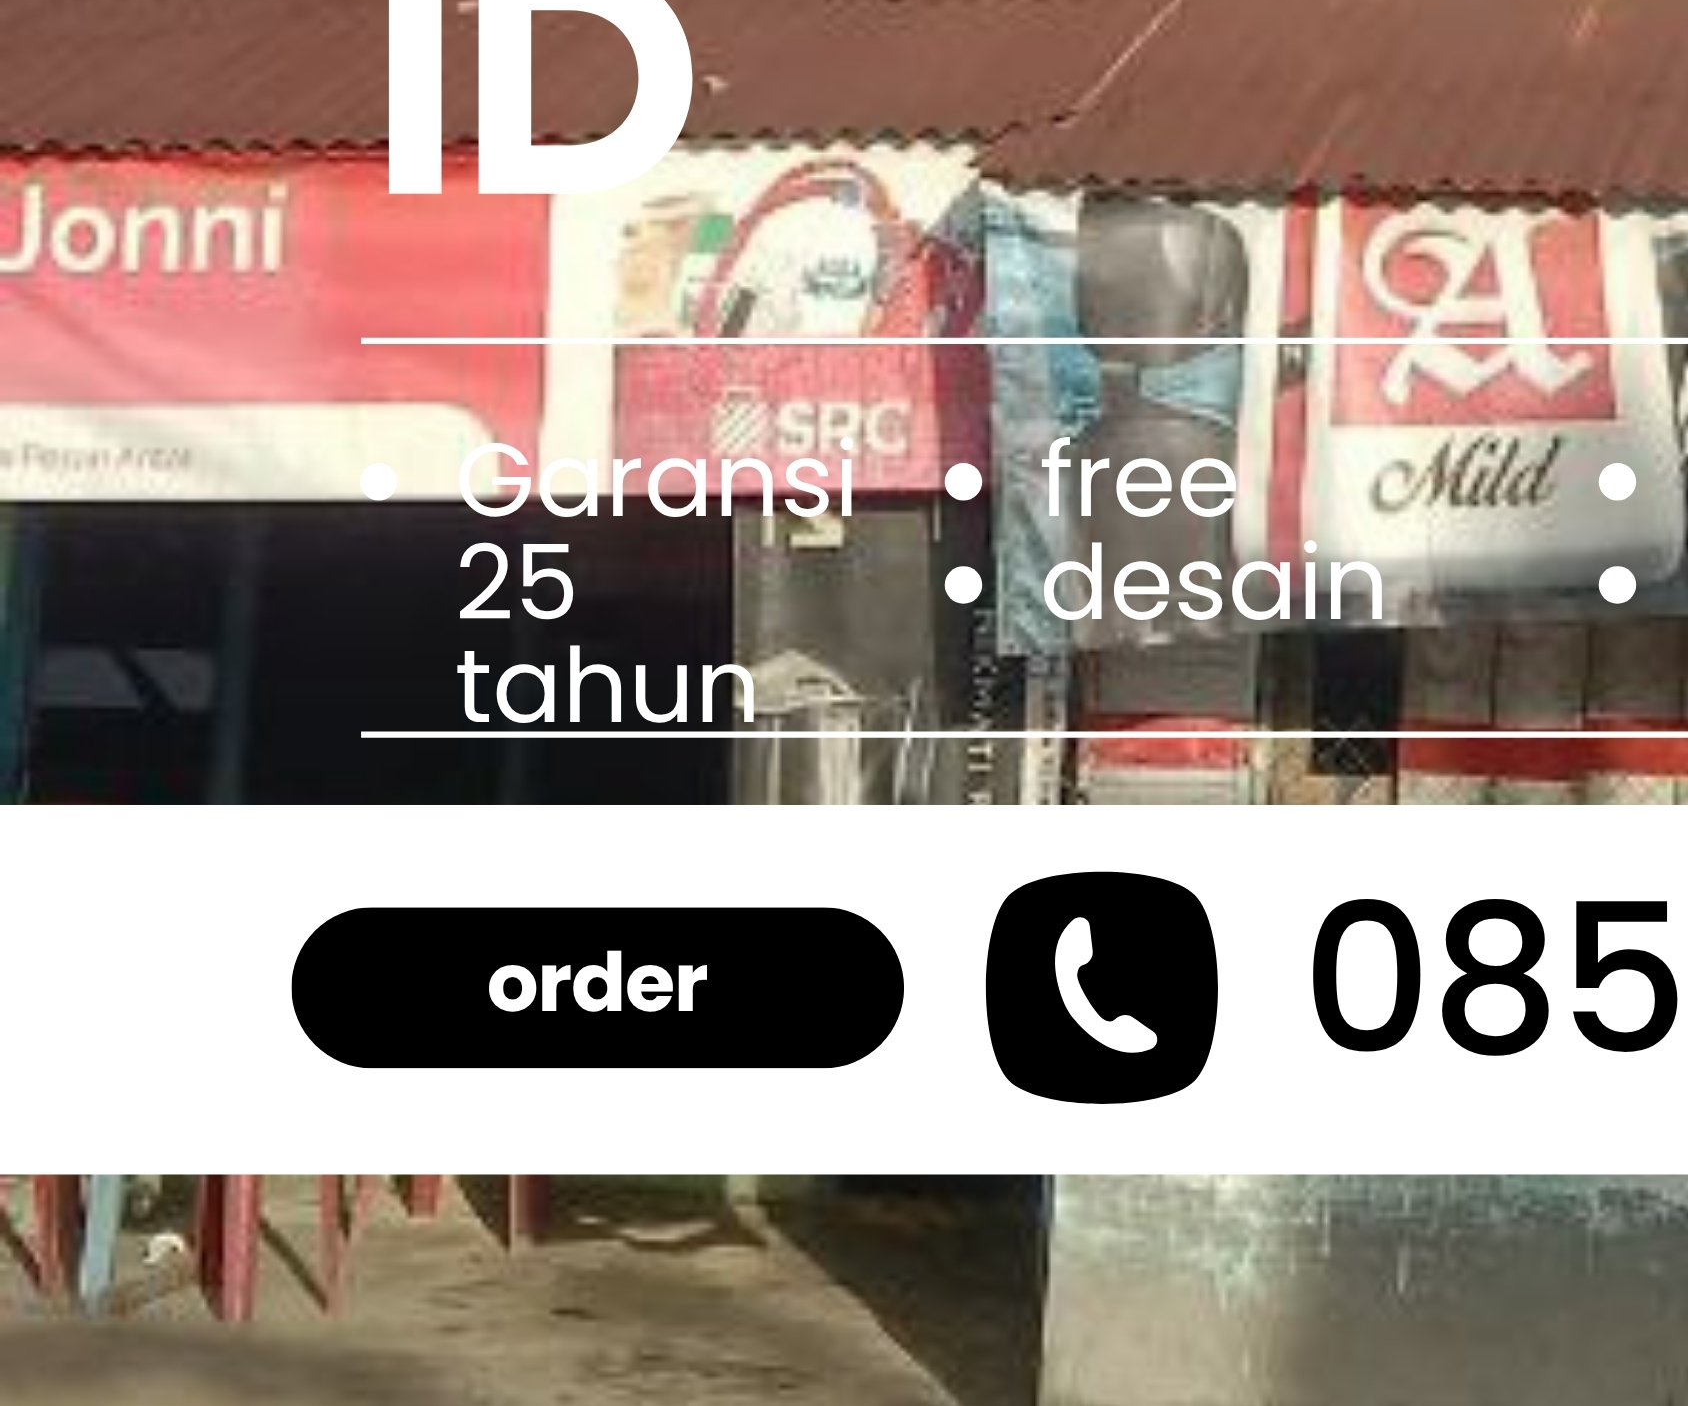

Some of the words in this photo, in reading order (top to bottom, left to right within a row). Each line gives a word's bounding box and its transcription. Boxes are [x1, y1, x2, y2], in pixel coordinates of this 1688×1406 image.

[0, 184, 288, 273] Jonni
[775, 397, 912, 455] SRC
[1369, 436, 1562, 514] Mild
